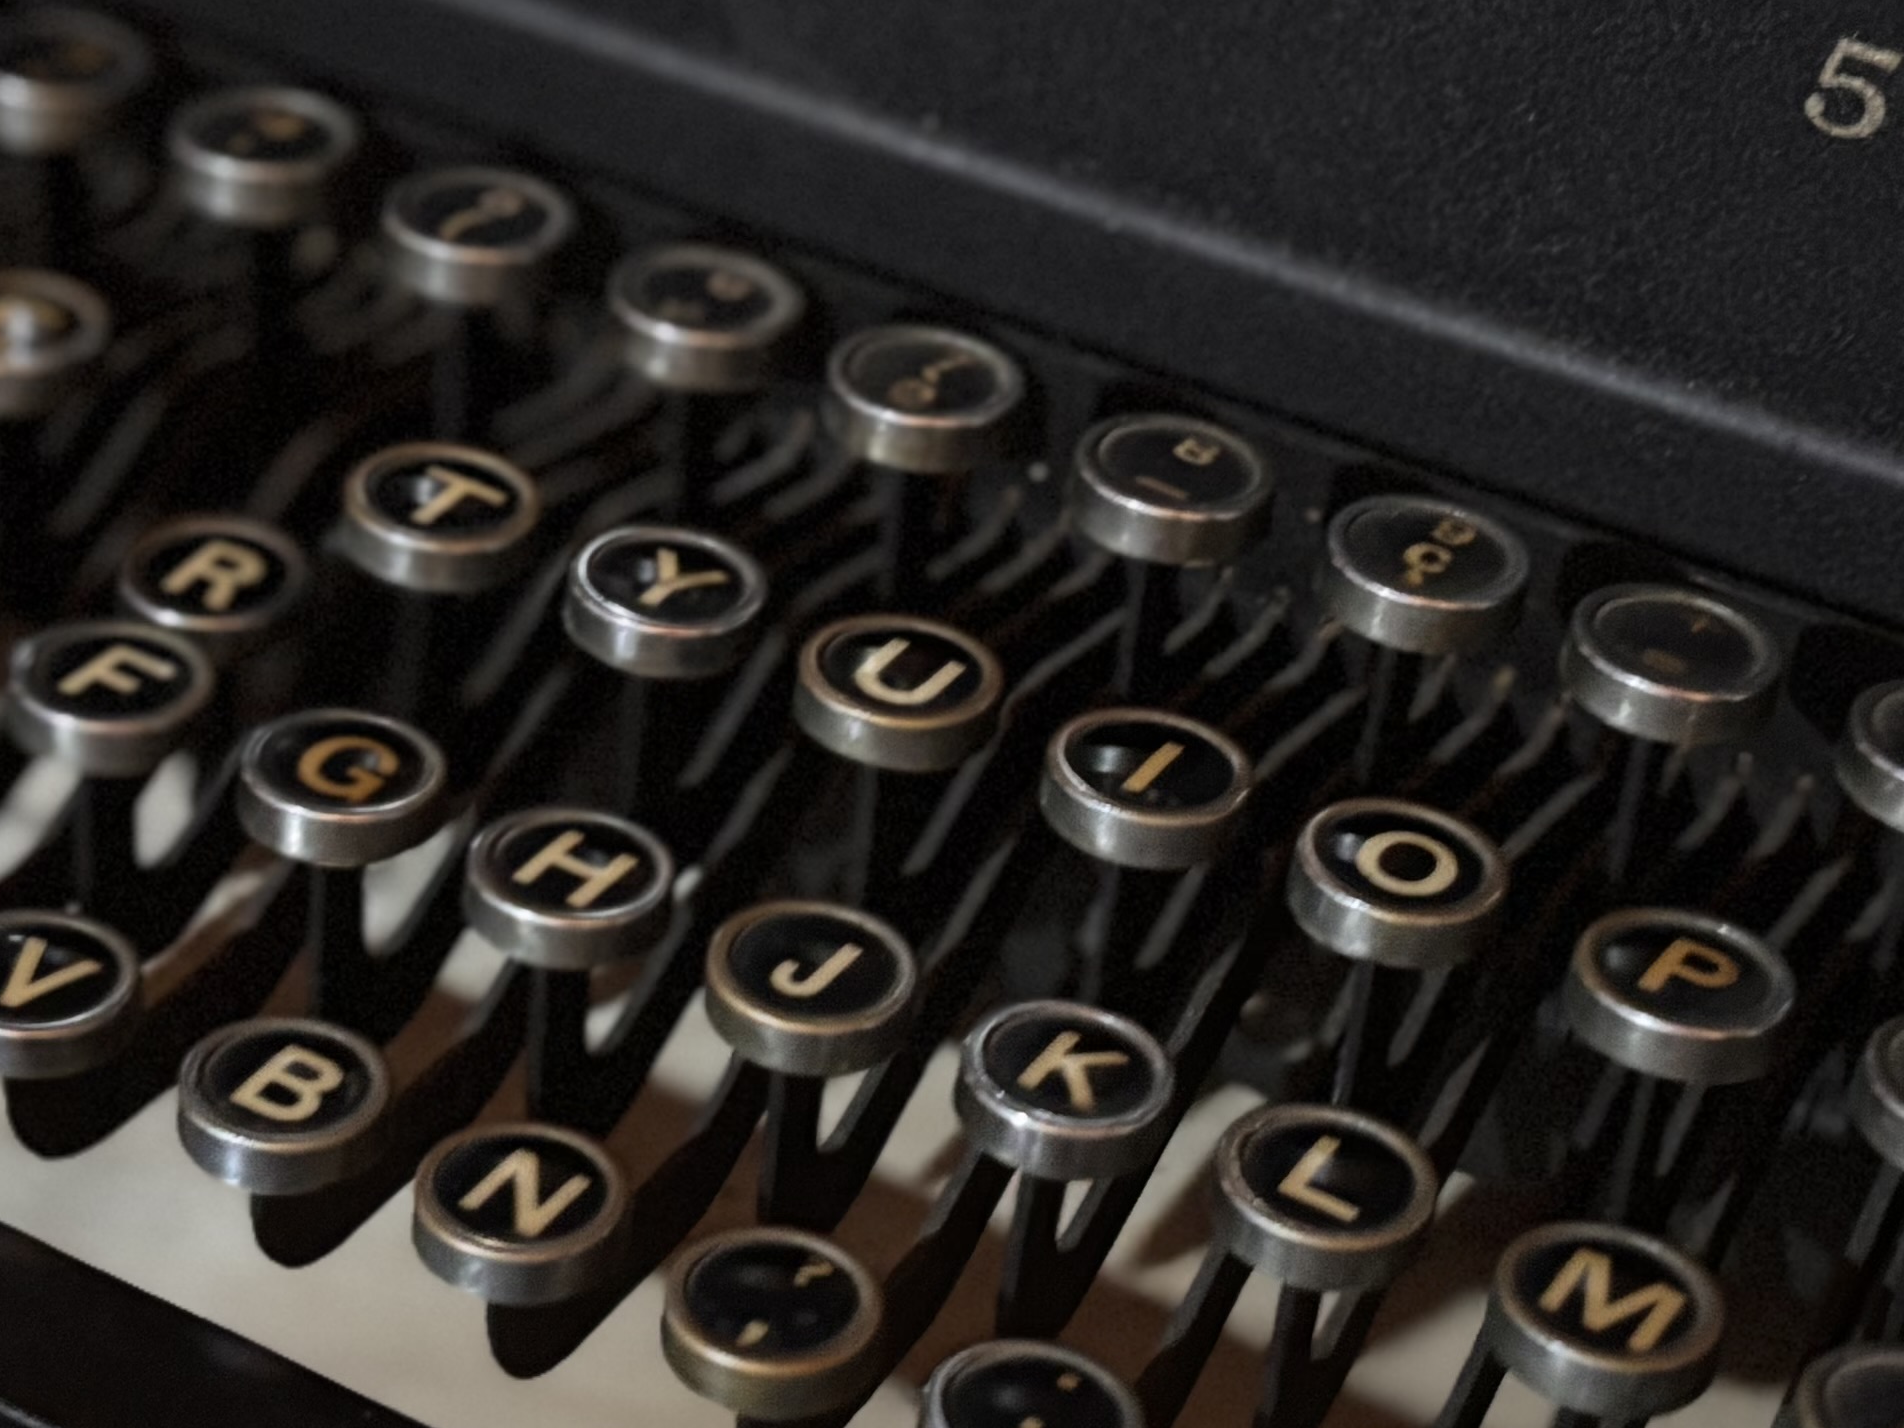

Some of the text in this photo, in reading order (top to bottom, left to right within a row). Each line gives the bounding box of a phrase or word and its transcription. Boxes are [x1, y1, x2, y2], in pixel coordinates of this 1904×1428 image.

[409, 464, 509, 524] T
[159, 538, 270, 612] R
[637, 546, 730, 608] Y
[56, 642, 179, 696] F
[854, 637, 966, 706] U
[298, 733, 399, 803] G
[1122, 739, 1185, 795] I
[511, 828, 640, 909] H
[1355, 829, 1459, 899] O
[769, 941, 864, 998] J
[1637, 936, 1741, 995] P
[229, 1043, 346, 1123] B
[1017, 1029, 1131, 1112] K
[456, 1147, 593, 1238] N
[1276, 1133, 1361, 1224] L
[1538, 1245, 1687, 1354] M
